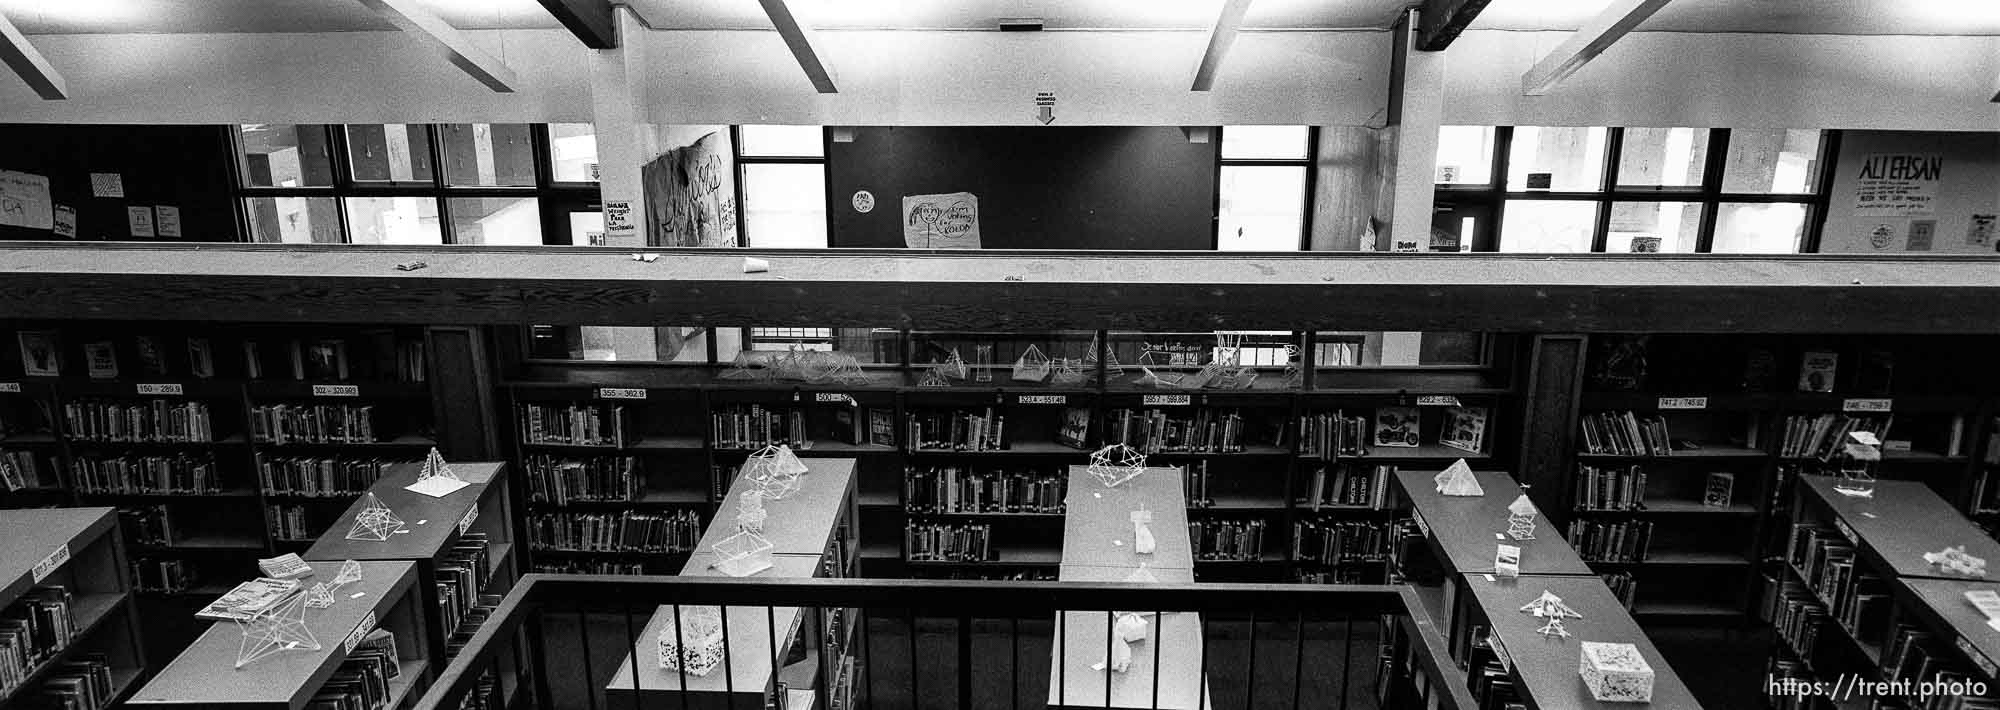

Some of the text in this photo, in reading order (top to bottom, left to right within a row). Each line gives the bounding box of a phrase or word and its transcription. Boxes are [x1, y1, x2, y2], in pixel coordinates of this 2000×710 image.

[1859, 155, 1943, 181] ALI EHSAN
[602, 389, 617, 397] 355
